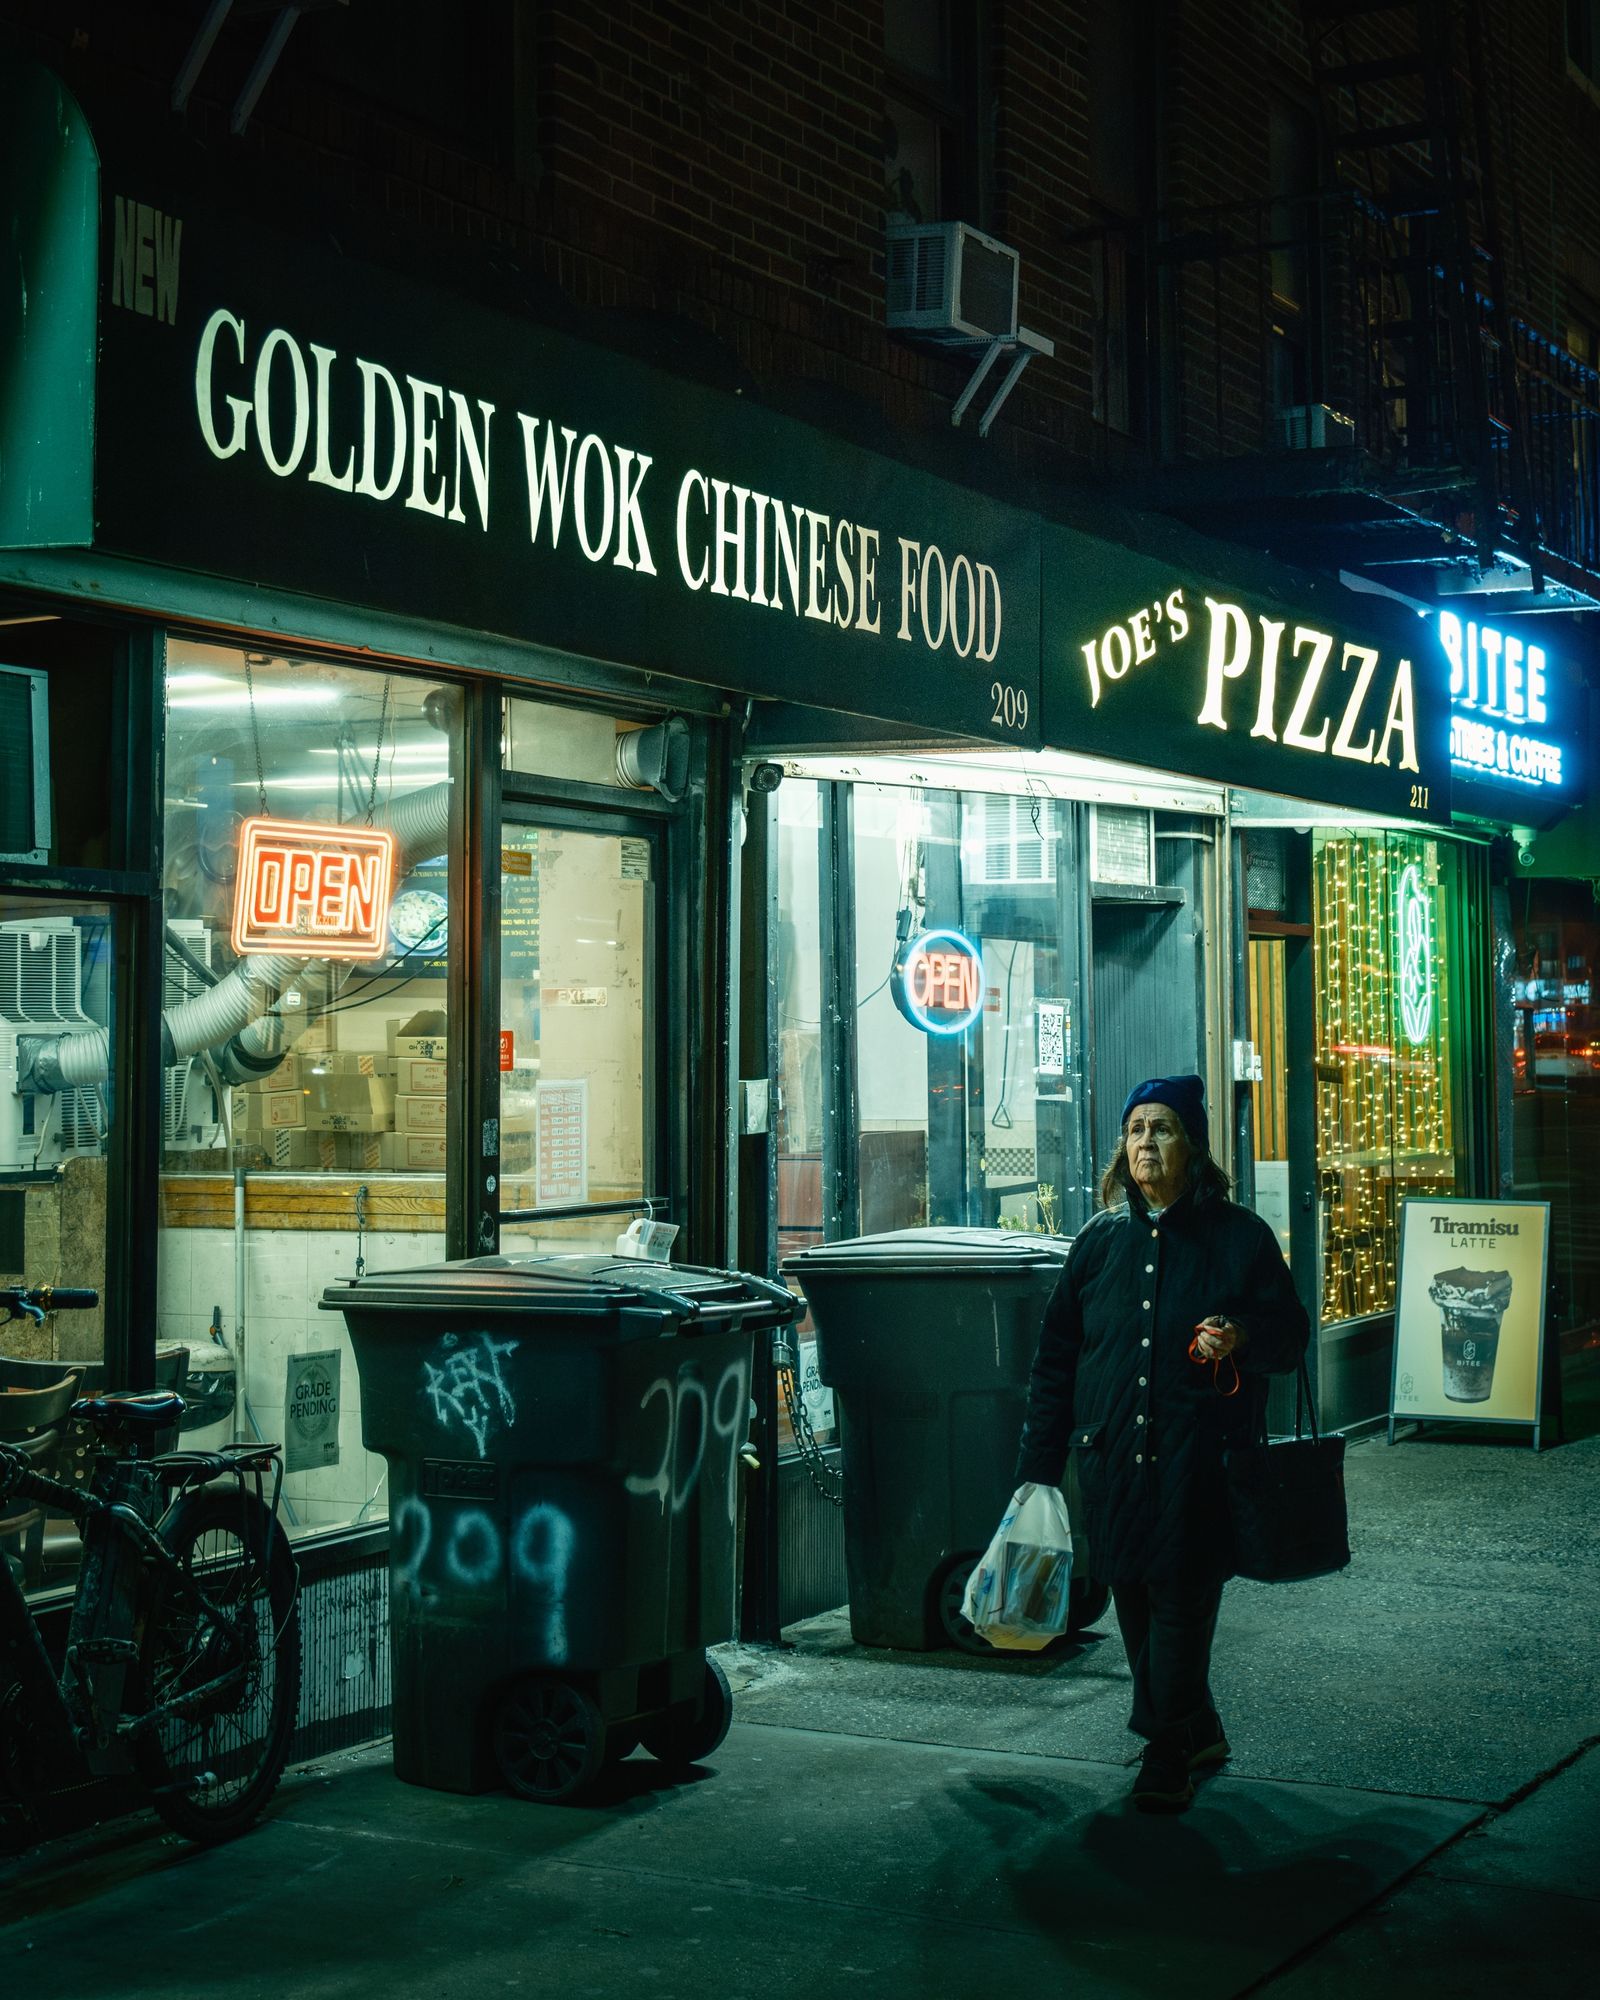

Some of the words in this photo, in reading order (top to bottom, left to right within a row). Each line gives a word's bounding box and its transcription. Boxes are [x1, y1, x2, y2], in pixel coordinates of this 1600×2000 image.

[112, 194, 182, 326] NEW
[195, 308, 496, 533] GOLDEN
[516, 411, 658, 577] WOK
[676, 468, 881, 635] CHINESE
[896, 536, 1002, 663] FOOD
[1080, 588, 1190, 709] JOE'S
[1196, 595, 1420, 774] PIZZA
[1439, 610, 1547, 724] BITEE
[990, 681, 1029, 731] 209
[1496, 730, 1509, 770] &
[1509, 734, 1563, 785] COFFEE
[1409, 784, 1429, 810] 211
[250, 846, 382, 933] OPEN
[908, 953, 978, 1010] OPEN
[1430, 1216, 1520, 1236] Tiramisu
[1450, 1237, 1497, 1249] LATTE
[291, 1397, 335, 1418] PENDING
[296, 1381, 331, 1400] GRADE
[392, 1495, 576, 1665] 209
